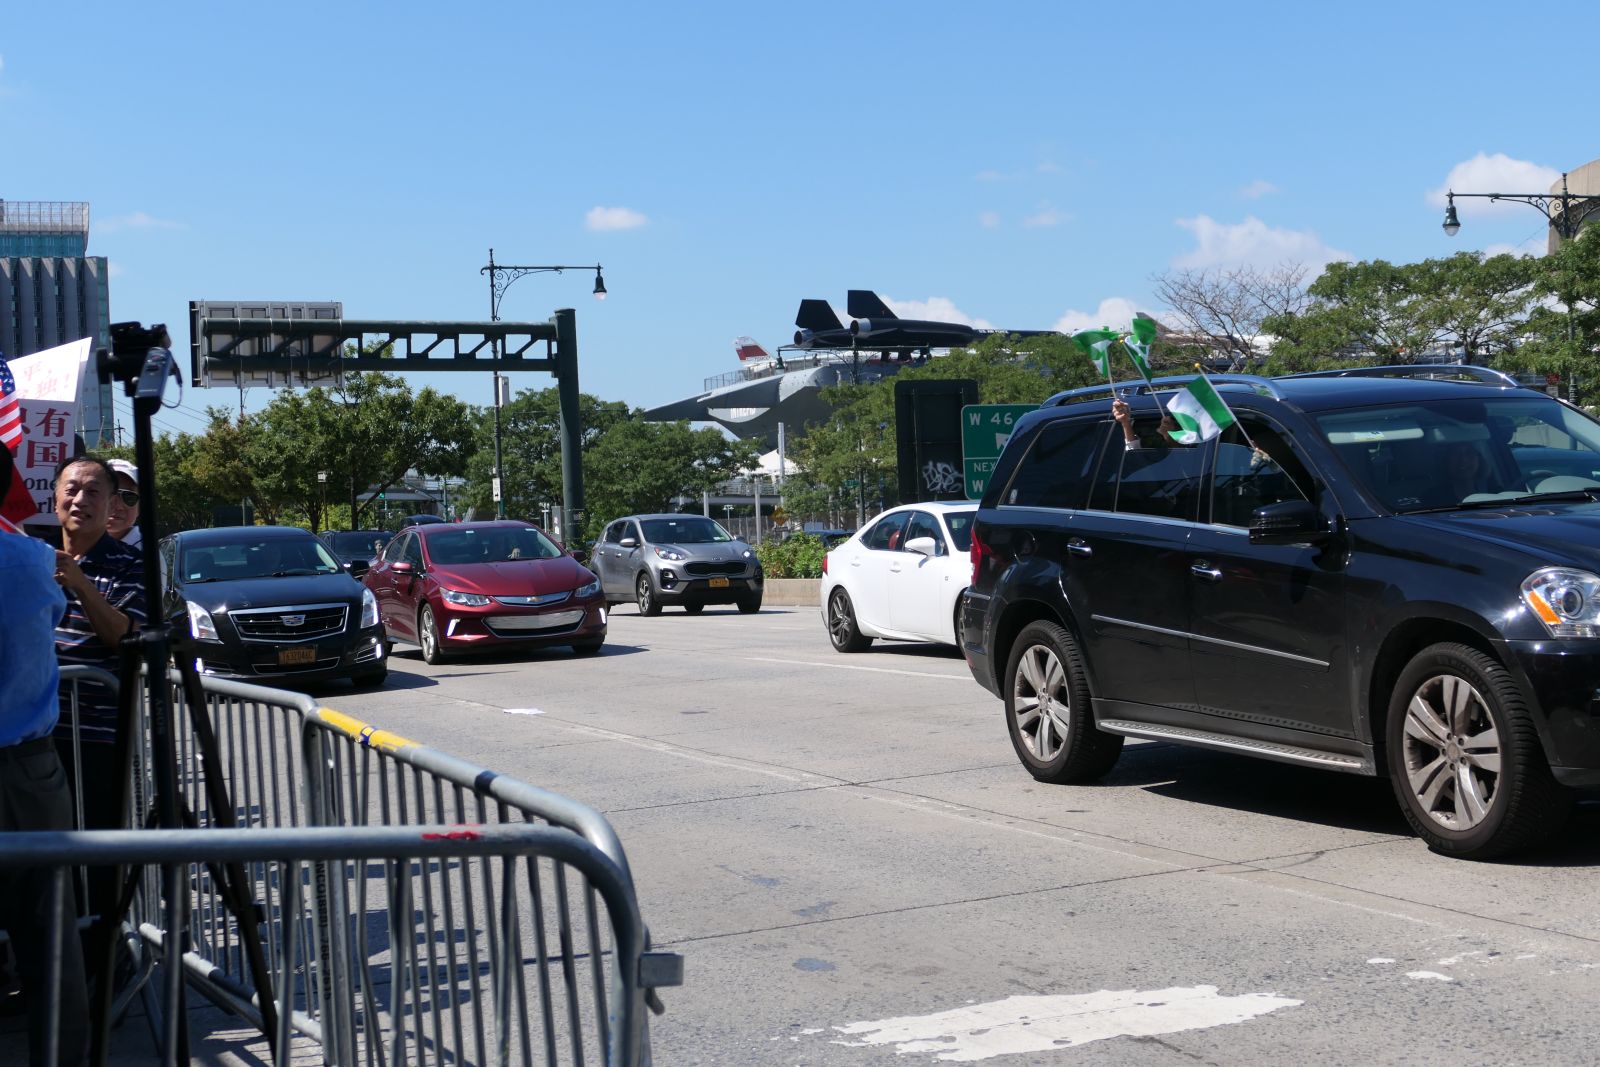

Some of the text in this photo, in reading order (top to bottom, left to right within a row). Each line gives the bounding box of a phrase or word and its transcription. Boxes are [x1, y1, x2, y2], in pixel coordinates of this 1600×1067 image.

[969, 412, 1013, 426] W 46
[973, 462, 996, 473] NEX
[972, 479, 984, 493] W
